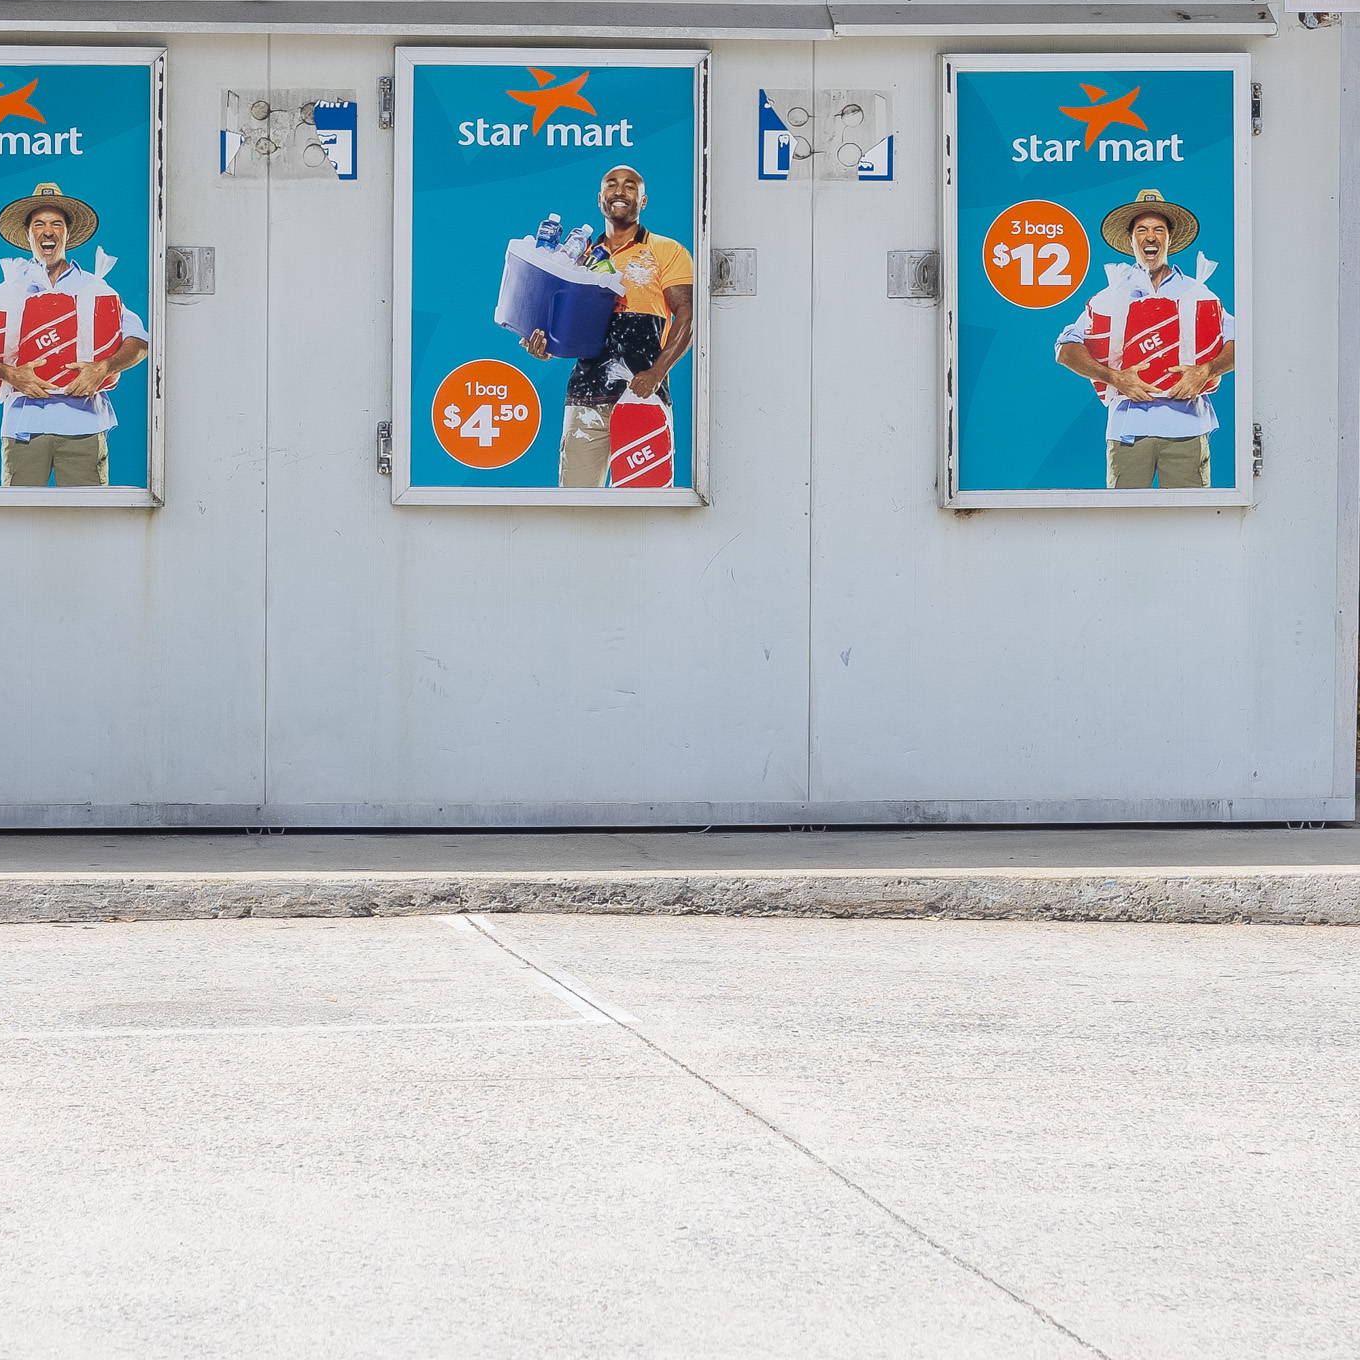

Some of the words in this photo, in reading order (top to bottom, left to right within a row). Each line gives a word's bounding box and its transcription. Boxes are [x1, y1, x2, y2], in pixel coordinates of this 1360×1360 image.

[457, 117, 529, 146] star
[547, 117, 634, 146] mart
[1011, 134, 1081, 162] star
[1098, 134, 1185, 162] mart
[1010, 220, 1021, 235] 3
[1025, 220, 1064, 238] bags
[992, 242, 1072, 286] $12
[35, 328, 61, 351] ICE
[1139, 332, 1164, 354] ICE
[465, 382, 471, 396] 1
[475, 381, 508, 401] bag
[626, 444, 655, 470] ICE
